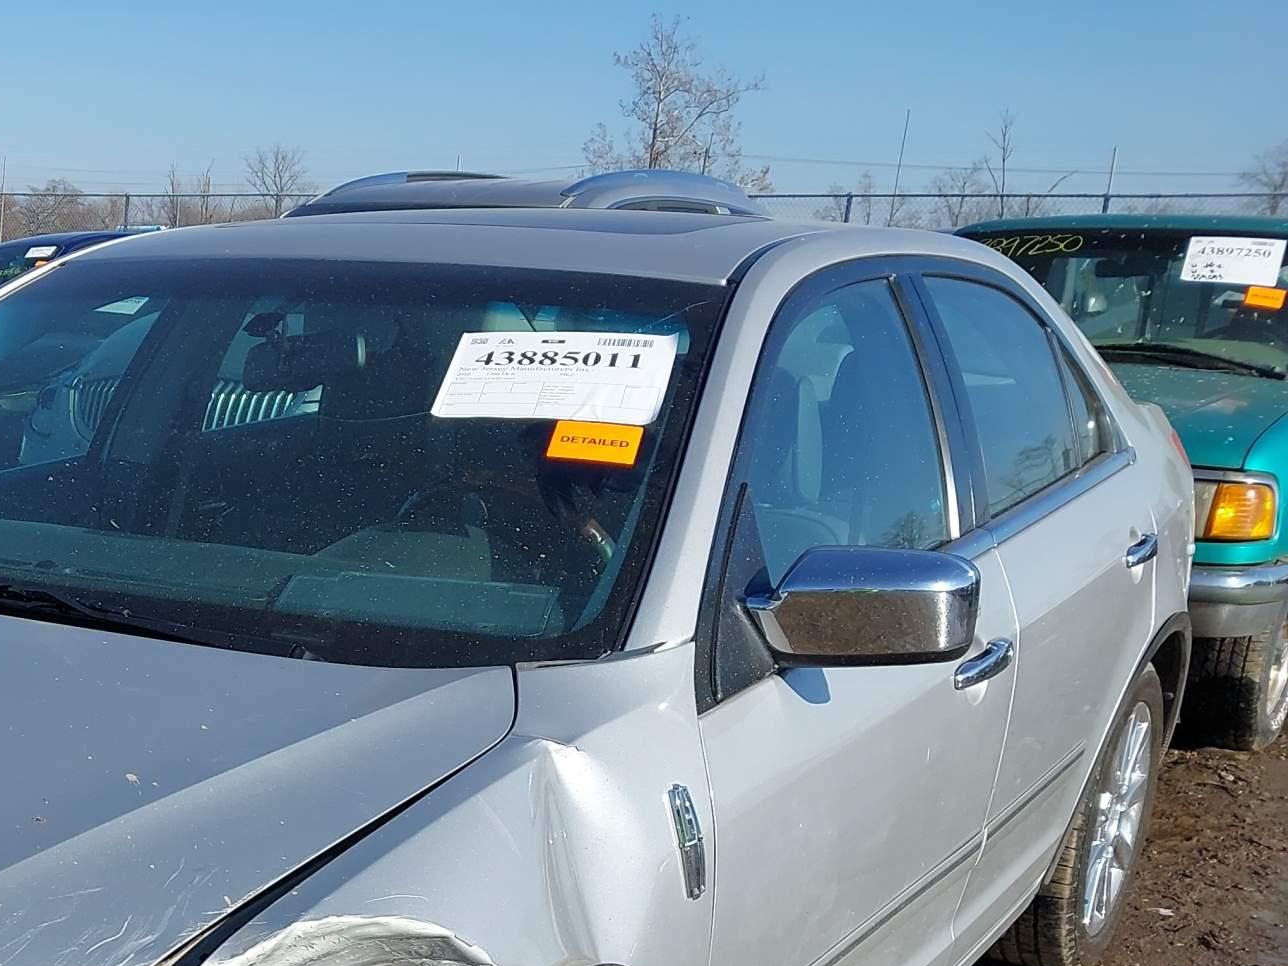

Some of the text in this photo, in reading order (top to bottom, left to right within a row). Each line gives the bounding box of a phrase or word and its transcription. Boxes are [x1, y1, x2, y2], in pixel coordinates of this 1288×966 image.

[1197, 247, 1272, 257] 43897250
[475, 351, 642, 369] 43885011
[560, 435, 630, 448] DETAILED
